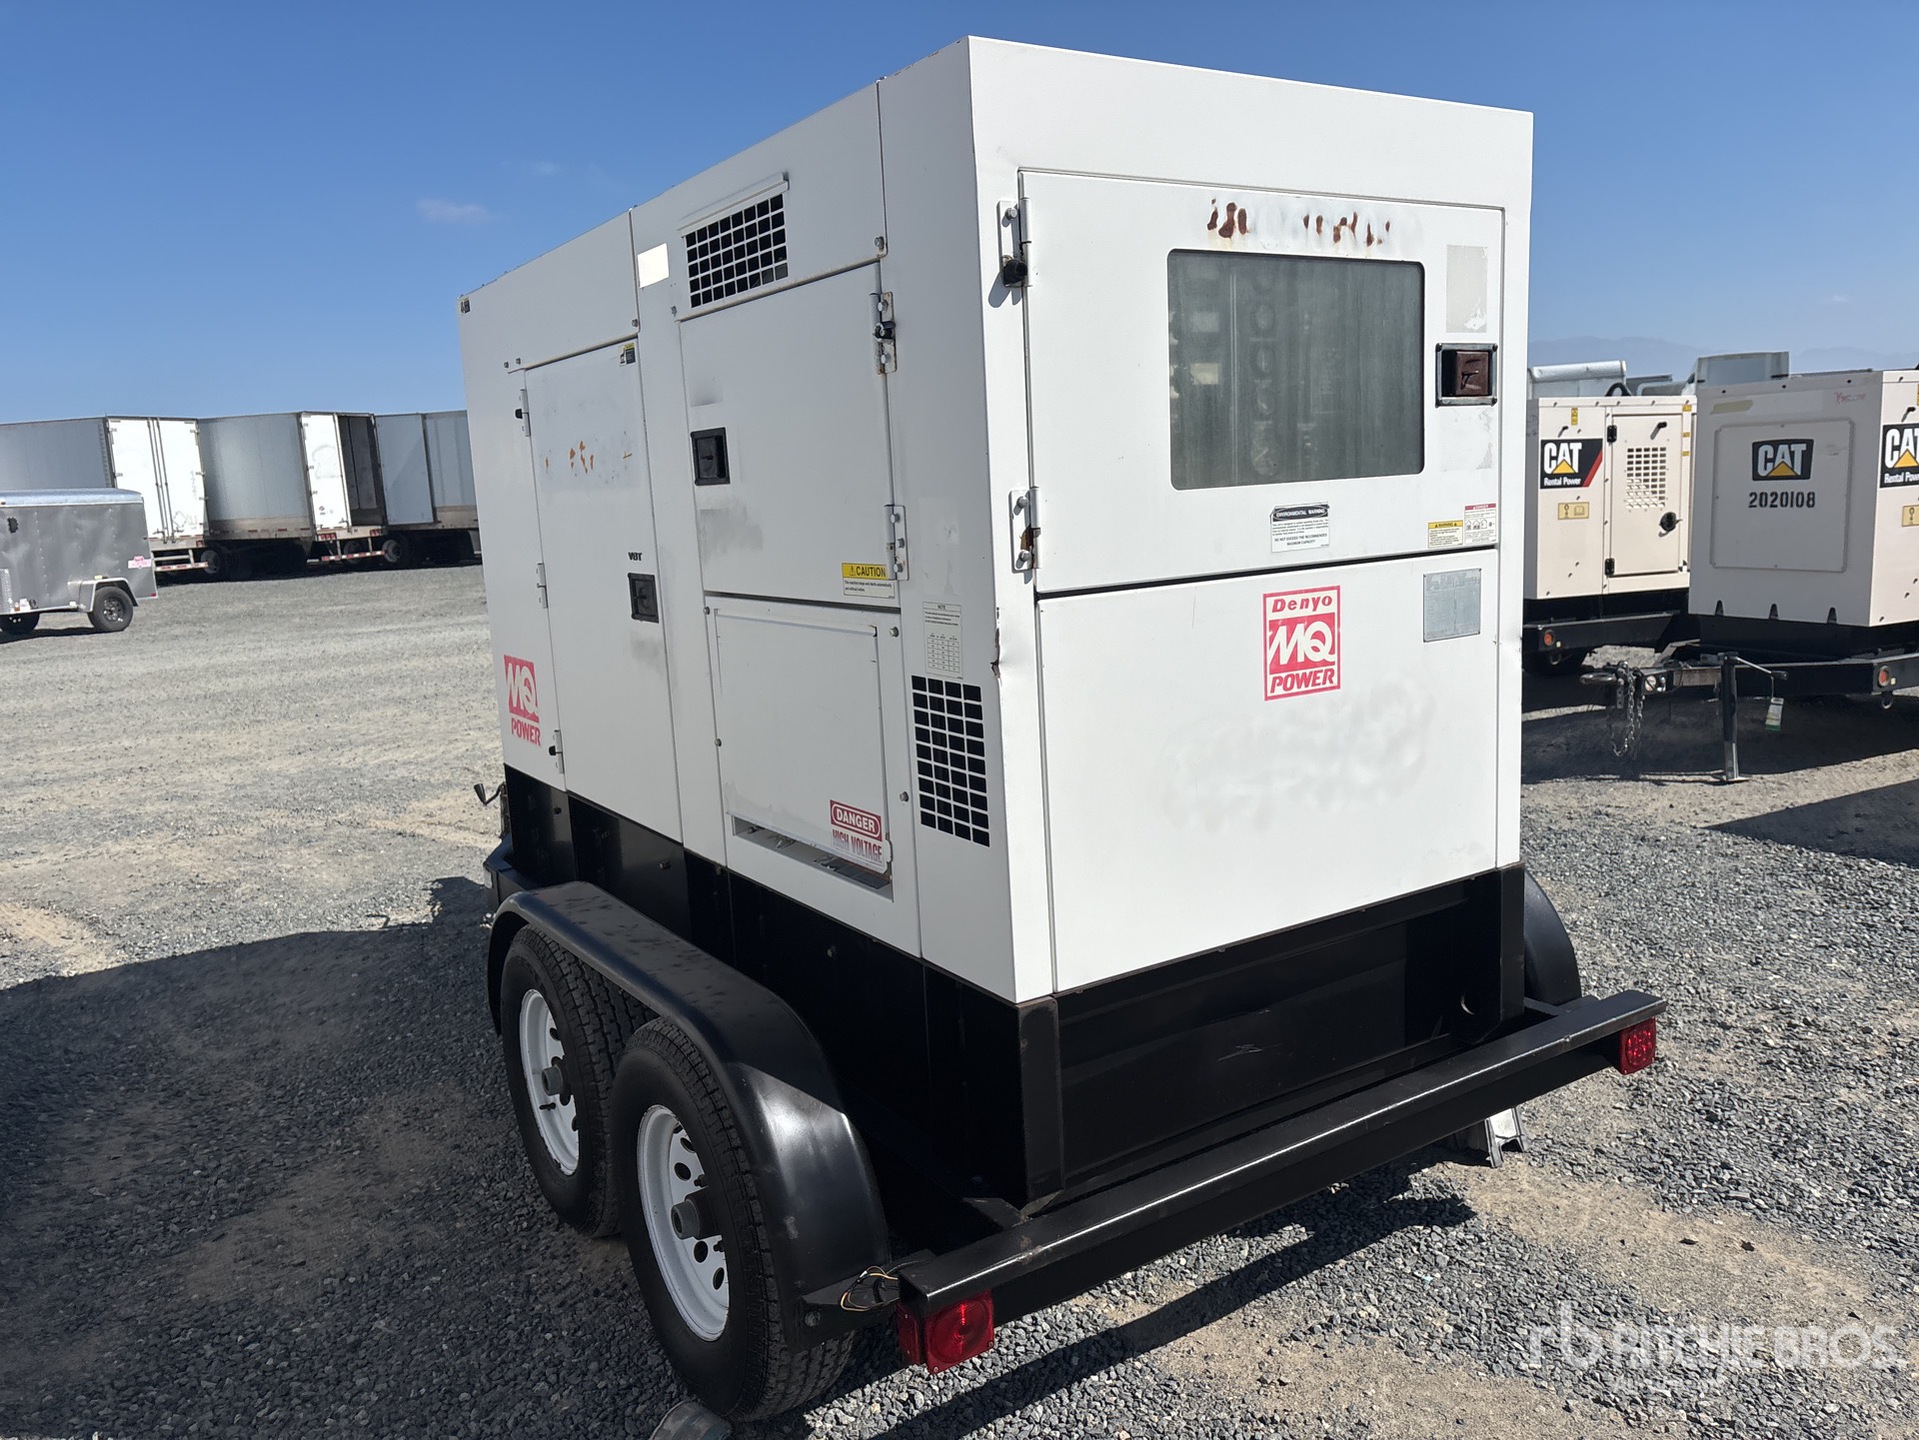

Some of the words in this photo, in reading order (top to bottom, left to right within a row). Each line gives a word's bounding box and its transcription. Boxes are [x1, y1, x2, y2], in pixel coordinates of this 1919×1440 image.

[1543, 442, 1582, 474] CAT
[1757, 443, 1807, 477] CAT
[1543, 477, 1562, 487] Rental
[1563, 476, 1581, 485] Power
[1884, 471, 1904, 484] Rental
[1748, 491, 1816, 509] 2020108
[856, 566, 886, 578] CAUTION
[1272, 595, 1333, 613] Denyo
[1269, 620, 1335, 666] MQ
[506, 662, 539, 716] MQ
[1270, 668, 1335, 694] POWER
[511, 717, 541, 749] POWER
[836, 808, 876, 833] DANGER
[850, 835, 882, 861] VOLTAGE
